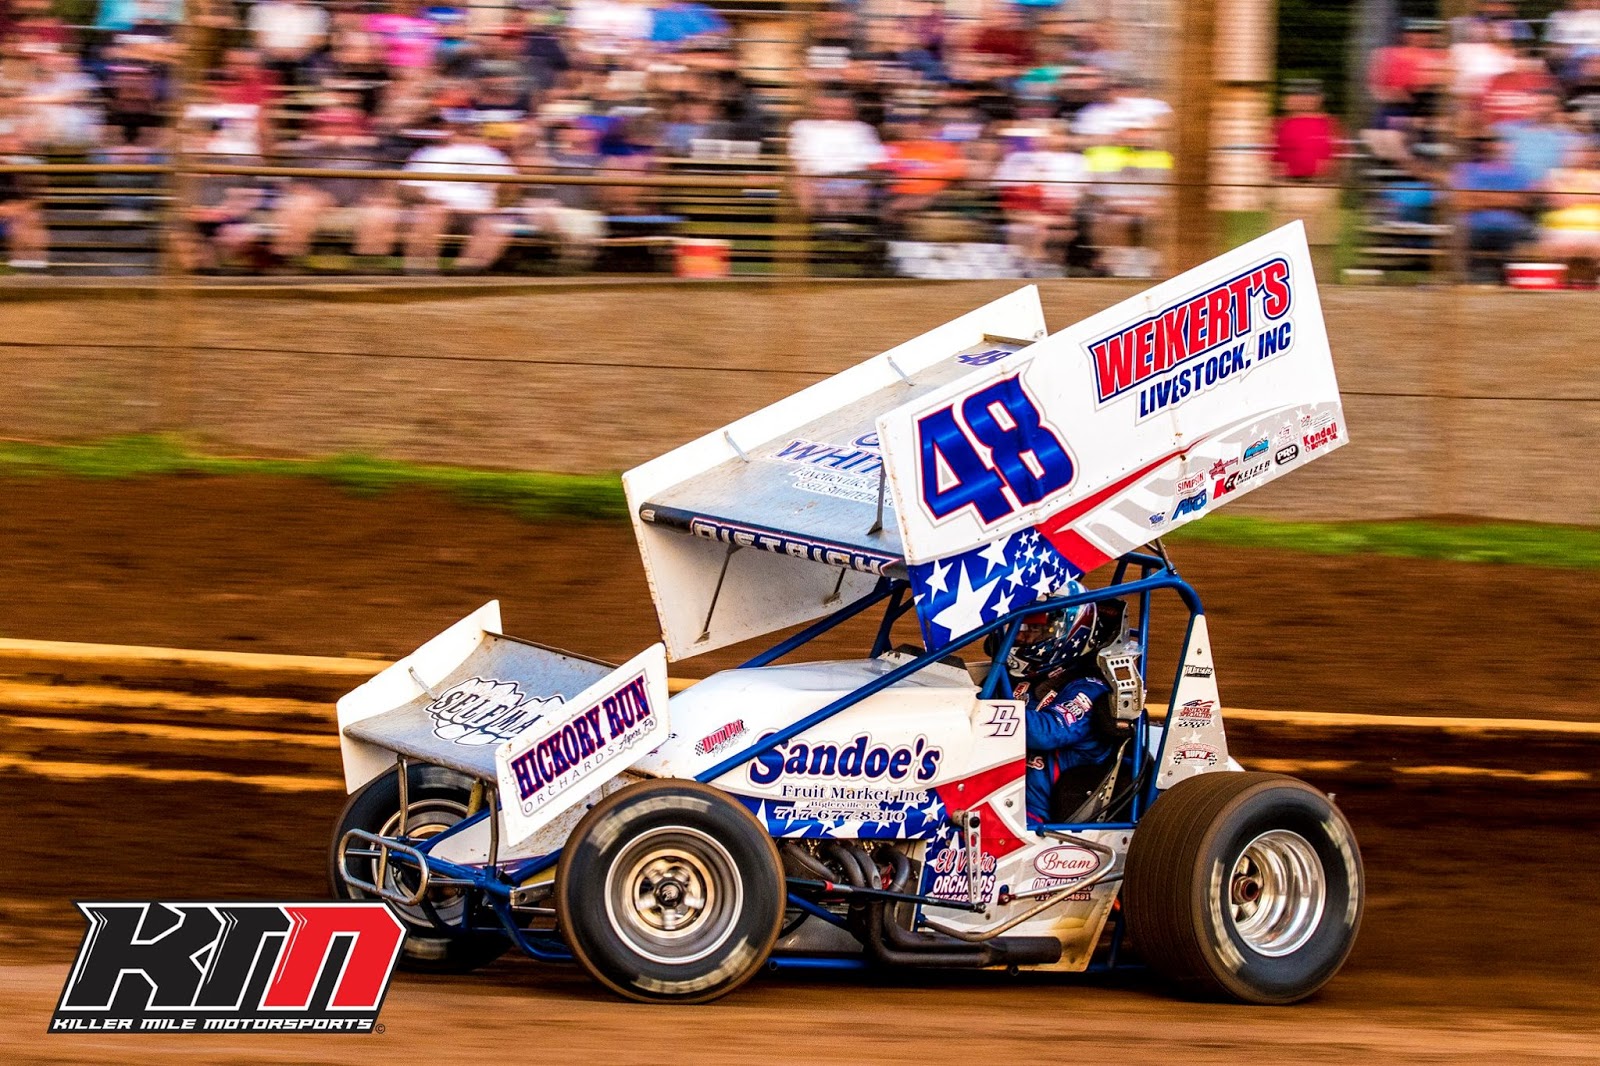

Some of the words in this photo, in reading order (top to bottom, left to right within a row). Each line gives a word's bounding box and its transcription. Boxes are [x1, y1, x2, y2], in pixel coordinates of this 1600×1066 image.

[1091, 260, 1291, 401] WEIKERT'S
[1139, 342, 1252, 418] LIVESTOCK,
[1257, 322, 1292, 361] INC
[1302, 422, 1337, 446] Kendall
[918, 372, 1075, 525] 48
[1277, 445, 1297, 461] PRO
[1237, 460, 1270, 481] KEIZER
[511, 703, 606, 801] HICKORY
[603, 675, 651, 740] RUN
[749, 732, 941, 785] Sandoe's
[524, 746, 616, 813] ORCHARDS
[782, 784, 825, 799] Fruit
[831, 787, 895, 803] Market,
[898, 789, 930, 802] Inc.
[775, 808, 907, 822] 717-677-8310
[934, 848, 957, 873] El
[957, 850, 996, 873] Vta
[1042, 851, 1095, 871] Bream
[933, 875, 995, 894] ORCHADS
